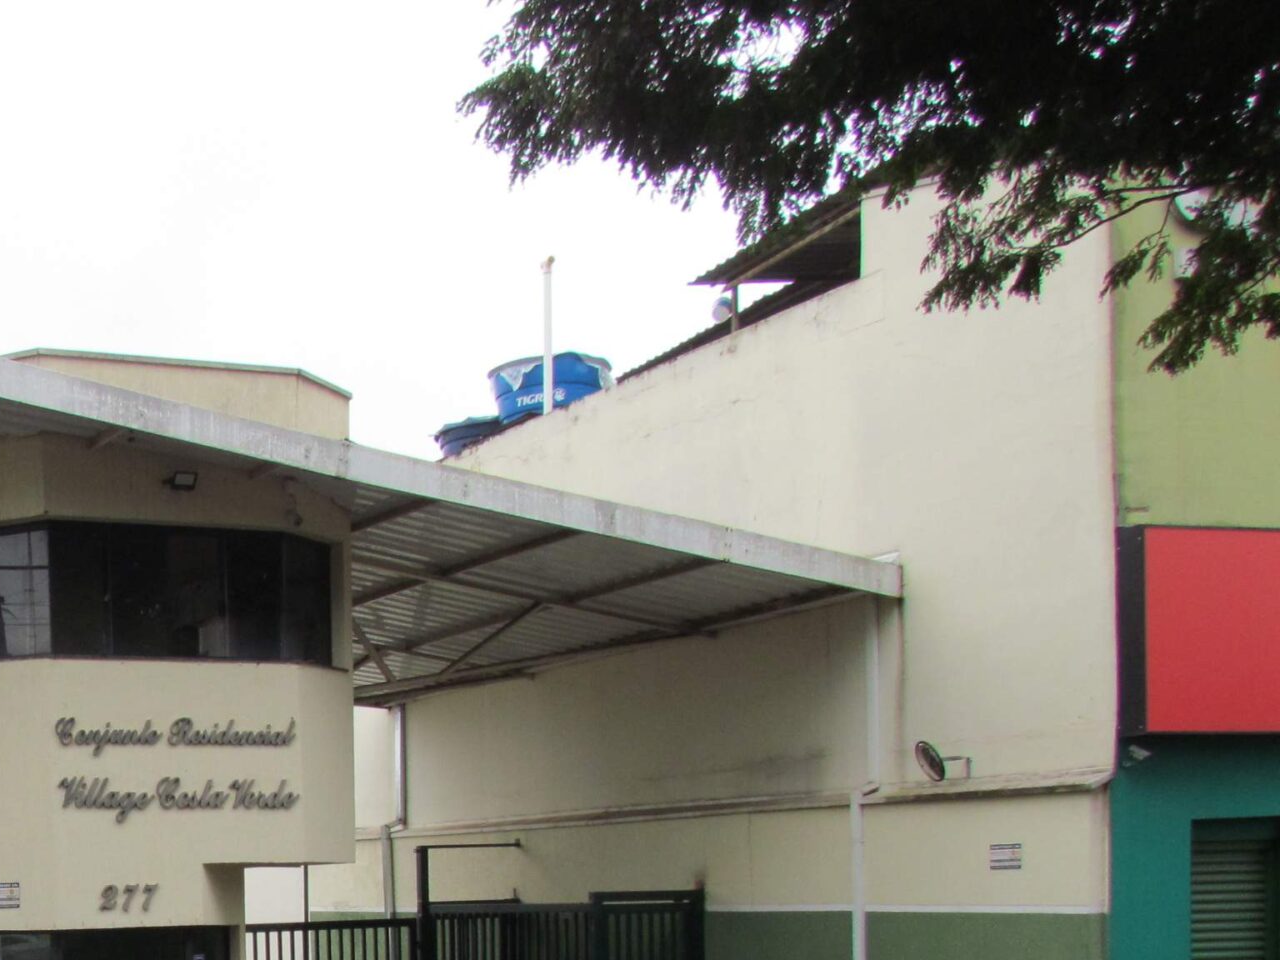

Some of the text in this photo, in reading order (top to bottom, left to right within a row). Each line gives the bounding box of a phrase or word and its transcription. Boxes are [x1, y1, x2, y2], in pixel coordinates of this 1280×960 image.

[516, 392, 545, 407] TIGR
[55, 717, 296, 757] Conjunto Residencial
[58, 776, 300, 824] Village Costa Verde
[99, 883, 159, 912] 277
